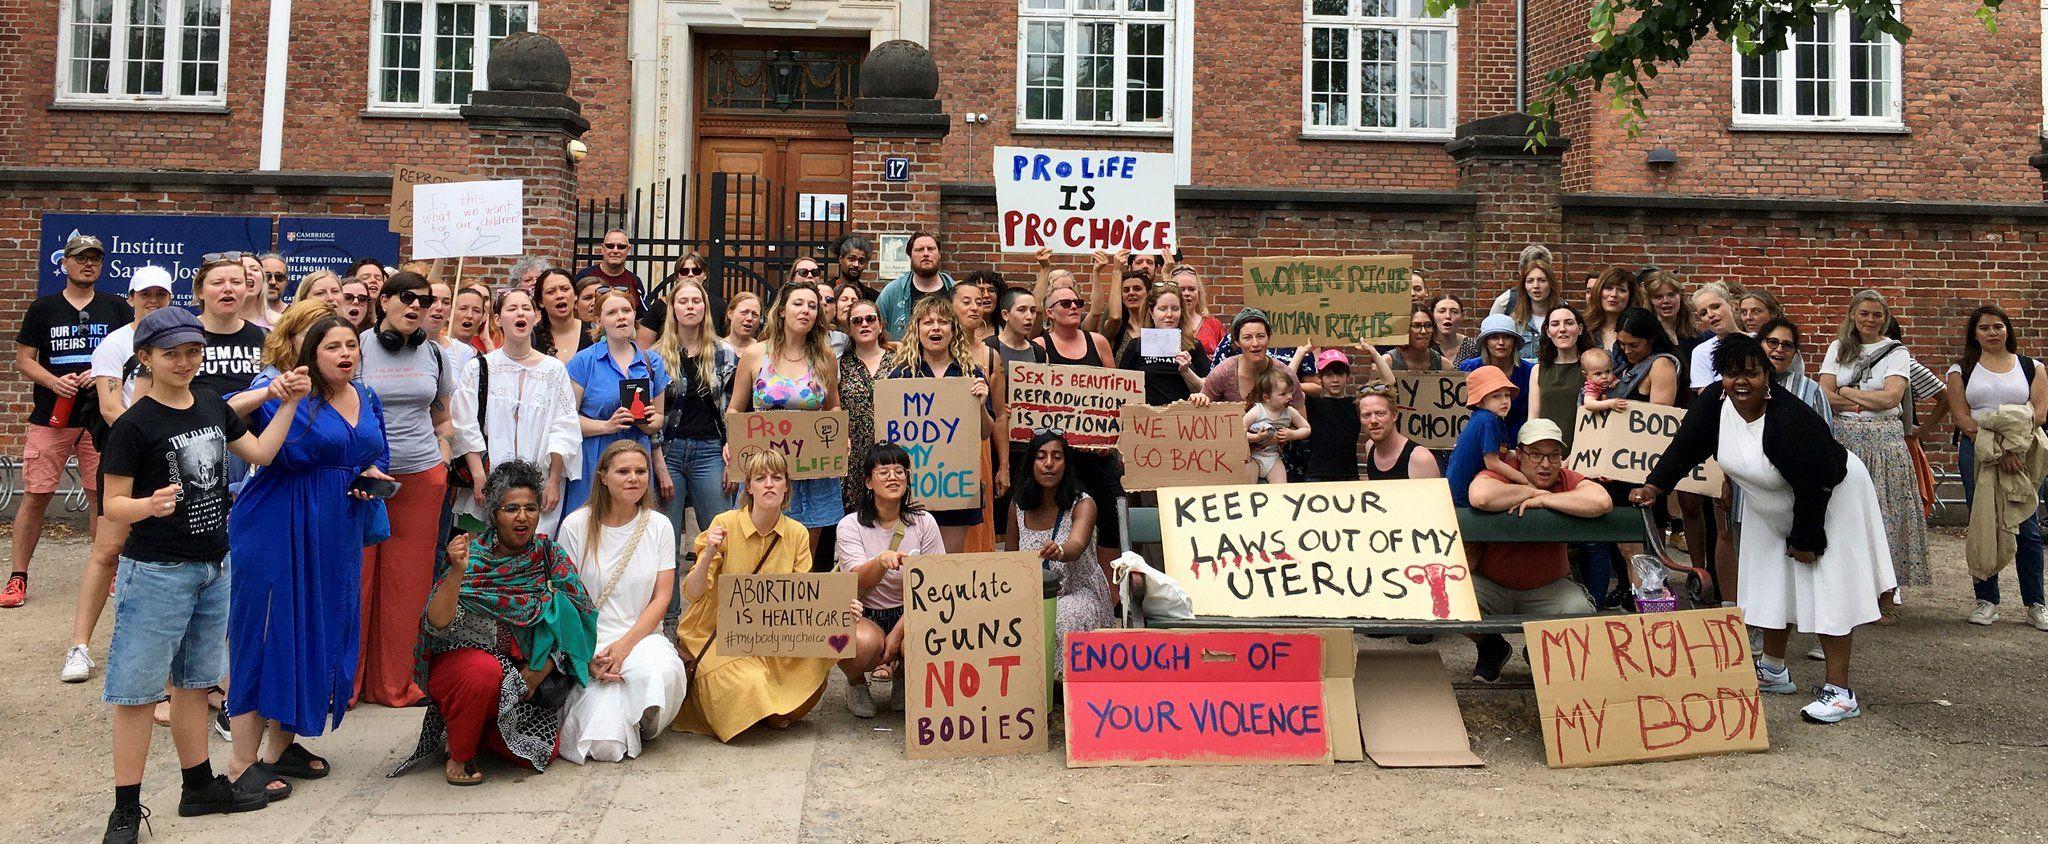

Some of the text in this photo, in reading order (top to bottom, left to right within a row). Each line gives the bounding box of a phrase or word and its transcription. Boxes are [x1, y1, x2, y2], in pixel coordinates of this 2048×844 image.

[889, 161, 905, 178] 17
[1013, 154, 1072, 181] PRO
[458, 192, 486, 205] this
[1058, 185, 1096, 211] IS
[422, 210, 450, 224] what
[463, 208, 479, 216] we
[485, 200, 513, 215] want
[456, 221, 473, 230] our
[1004, 210, 1057, 246] PRO
[110, 235, 184, 255] Institut
[285, 256, 353, 264] INTERNATIONAL
[1250, 261, 1409, 297] WOMENS RIGHTS
[50, 324, 108, 338] OUR PNET
[1325, 311, 1393, 343] RIGHTS
[50, 337, 105, 351] THEIRS TO
[904, 392, 935, 417] MY
[1394, 377, 1468, 409] Y BO
[747, 414, 792, 439] PRO
[887, 417, 960, 444] BODY
[1041, 411, 1125, 434] OPTiONA
[1133, 414, 1239, 441] WE WON'T
[1408, 413, 1471, 439] CHOIC
[1579, 409, 1681, 438] MY BOD
[770, 438, 804, 458] MY
[901, 443, 934, 469] MY
[1133, 443, 1233, 473] GO BACK
[796, 455, 843, 472] LIFE
[1572, 447, 1707, 481] MY CHOE
[911, 461, 975, 498] HOiCE
[1174, 490, 1388, 527] KEEP YOUR
[1190, 528, 1459, 562] LAWS OUT OF MY
[730, 578, 820, 607] ABORTION
[1227, 561, 1408, 600] UTERUS
[910, 567, 1011, 624] Regulate
[736, 608, 753, 625] IS
[1070, 641, 1292, 672] ENOUGH OF
[1541, 622, 1591, 686] MY
[925, 655, 1020, 708] NOT
[1086, 698, 1321, 738] YOUR VIOLENCE
[1555, 687, 1760, 763] MY BODY
